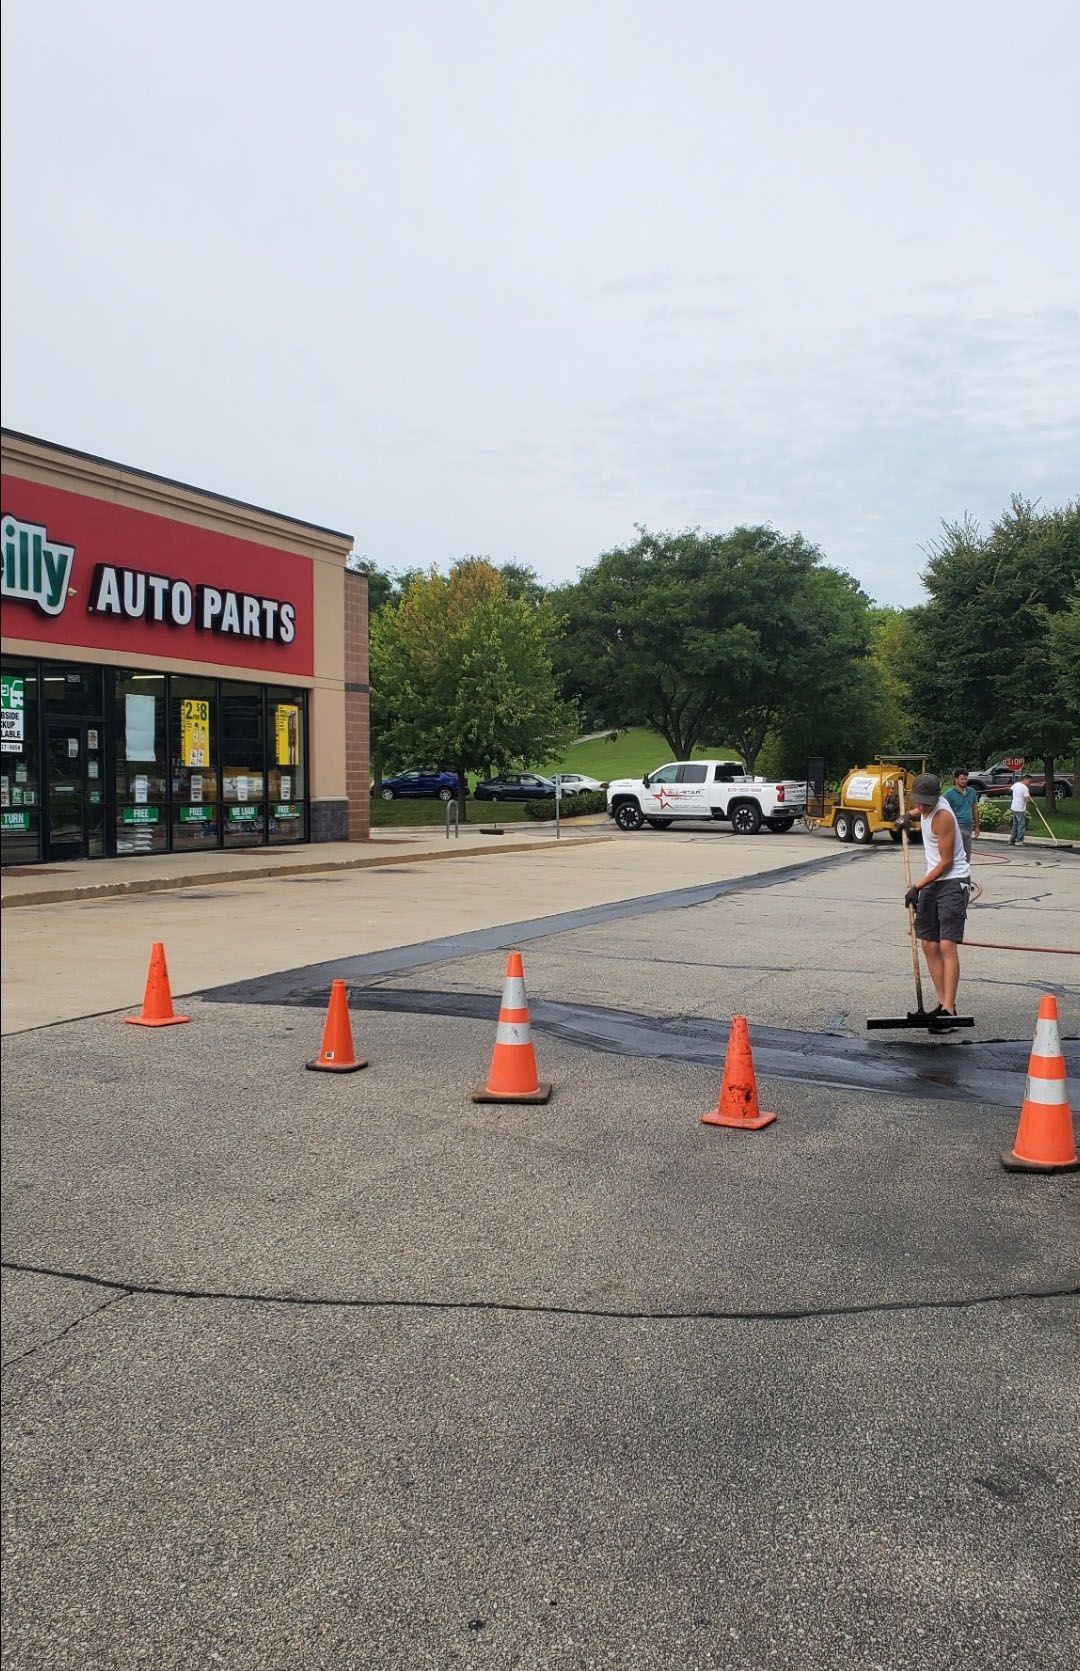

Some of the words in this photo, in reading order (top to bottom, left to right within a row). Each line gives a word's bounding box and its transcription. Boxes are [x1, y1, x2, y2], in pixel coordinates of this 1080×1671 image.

[1, 524, 69, 607] illy
[97, 566, 193, 627] AUTO
[203, 587, 296, 644] PARTS
[185, 702, 192, 719] 2
[1, 721, 15, 729] KUP
[1006, 758, 1023, 767] STOP
[133, 808, 149, 818] FREE
[189, 807, 203, 816] FREE
[231, 807, 240, 816] WE
[241, 806, 255, 815] LOAN
[277, 805, 290, 813] FREE
[4, 813, 24, 824] TURN
